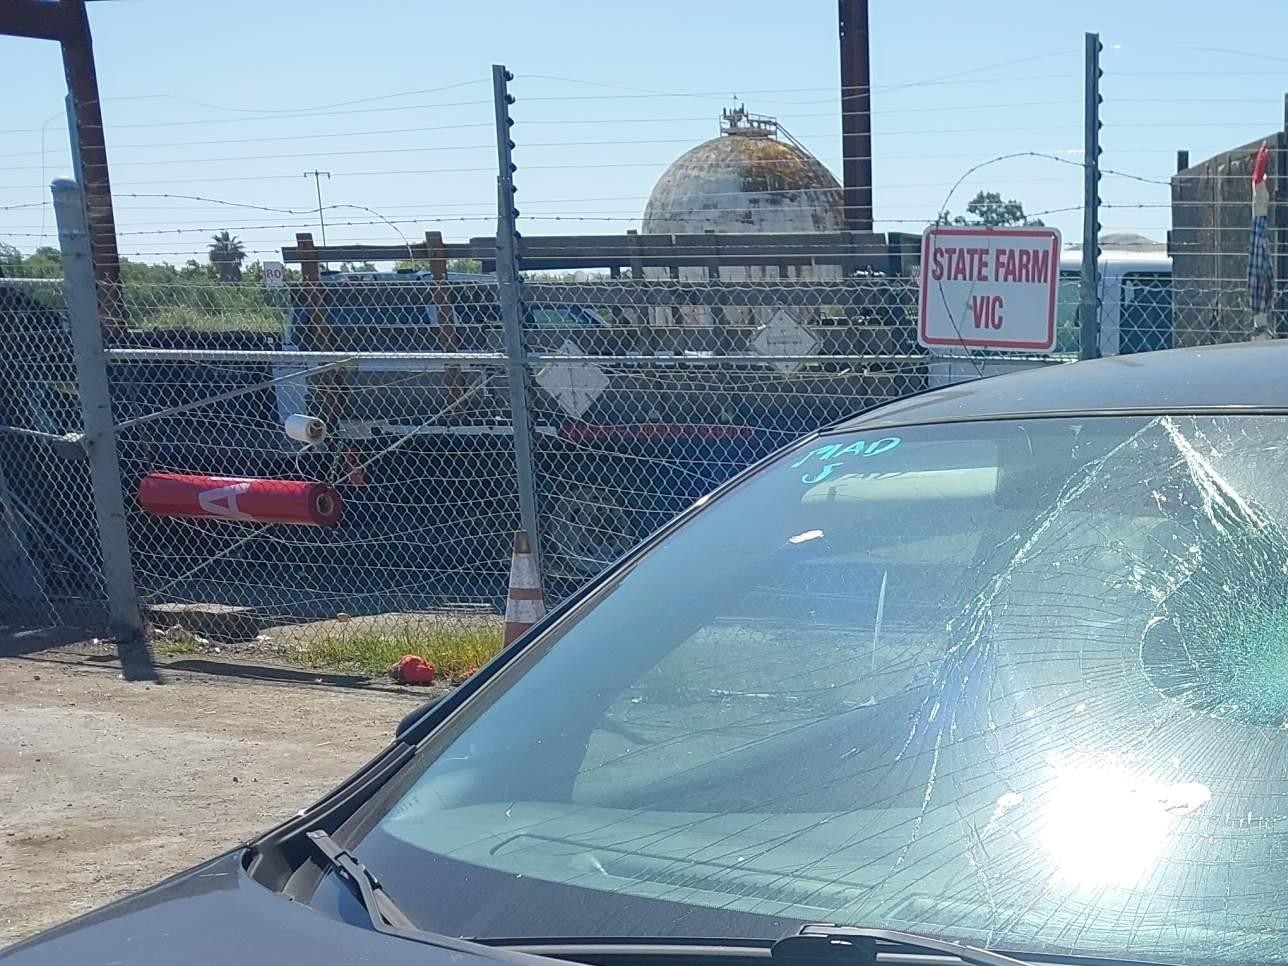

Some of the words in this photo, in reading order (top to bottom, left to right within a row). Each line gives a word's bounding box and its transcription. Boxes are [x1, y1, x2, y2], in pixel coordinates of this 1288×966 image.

[932, 247, 989, 282] STATE
[994, 248, 1050, 283] FARM
[972, 295, 1004, 330] VIC
